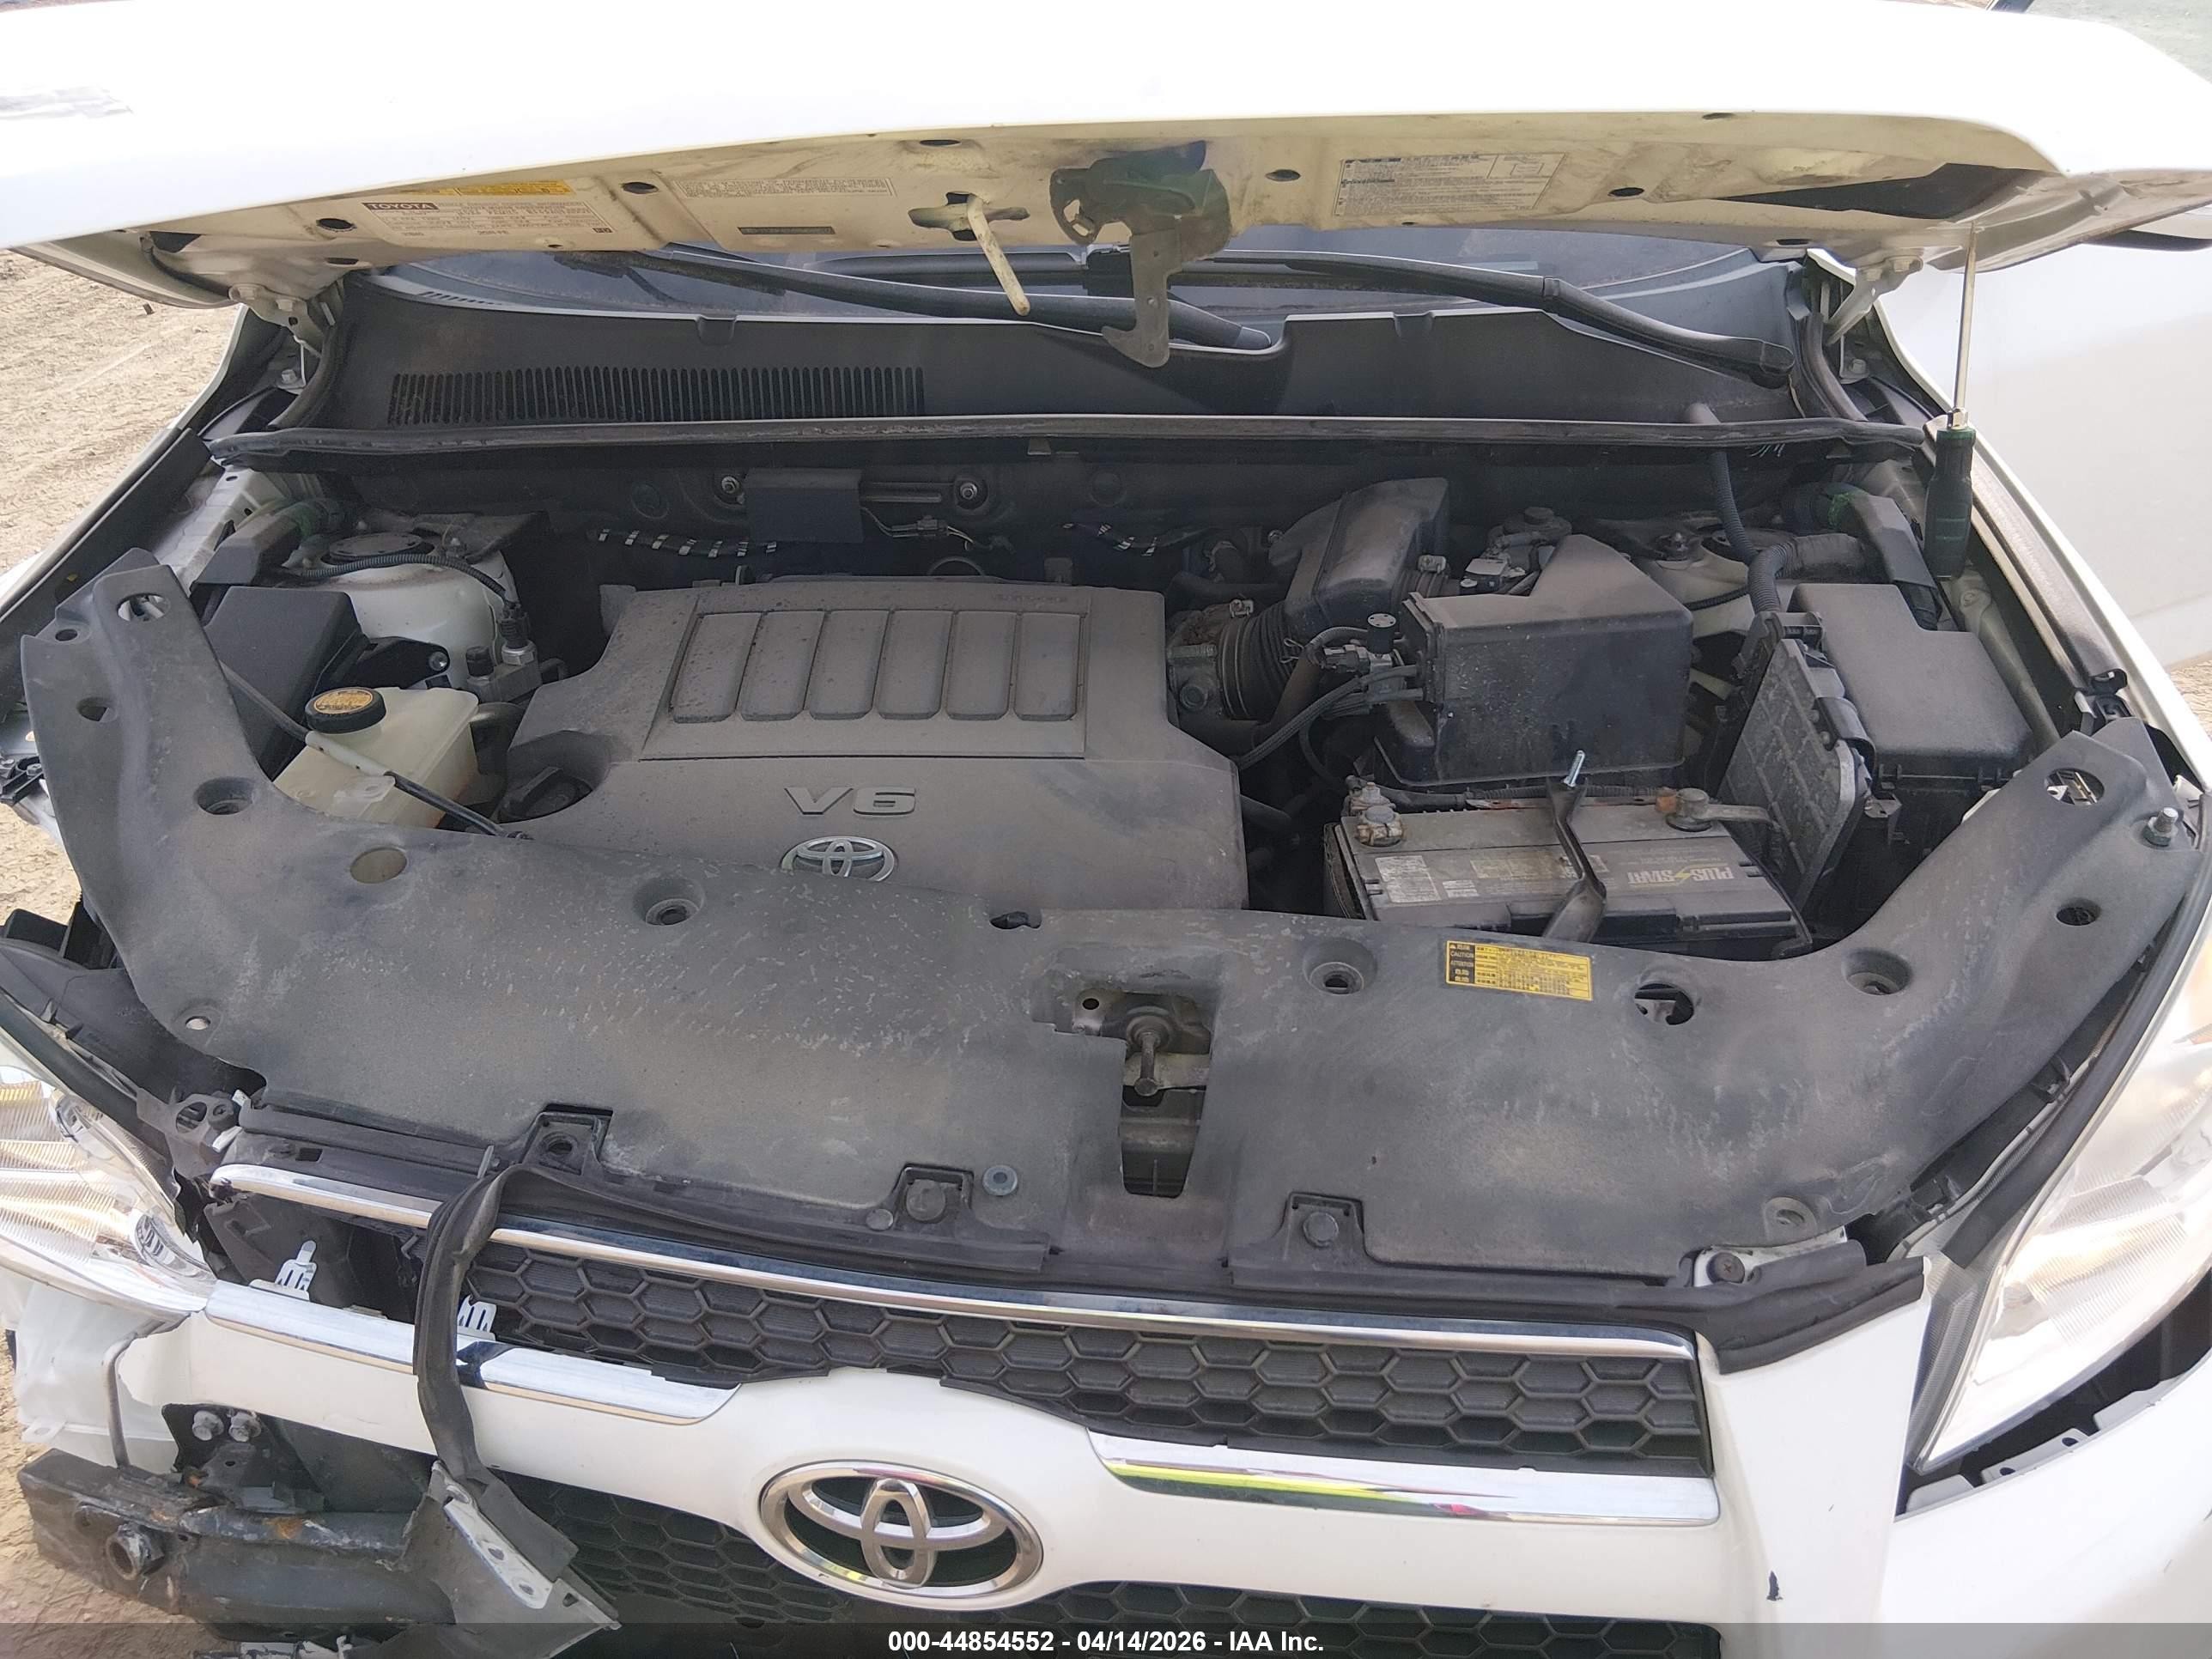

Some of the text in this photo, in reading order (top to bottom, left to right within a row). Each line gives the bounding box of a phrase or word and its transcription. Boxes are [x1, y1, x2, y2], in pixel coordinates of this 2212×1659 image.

[783, 786, 917, 817] V6
[1626, 866, 1735, 884] PLUS START
